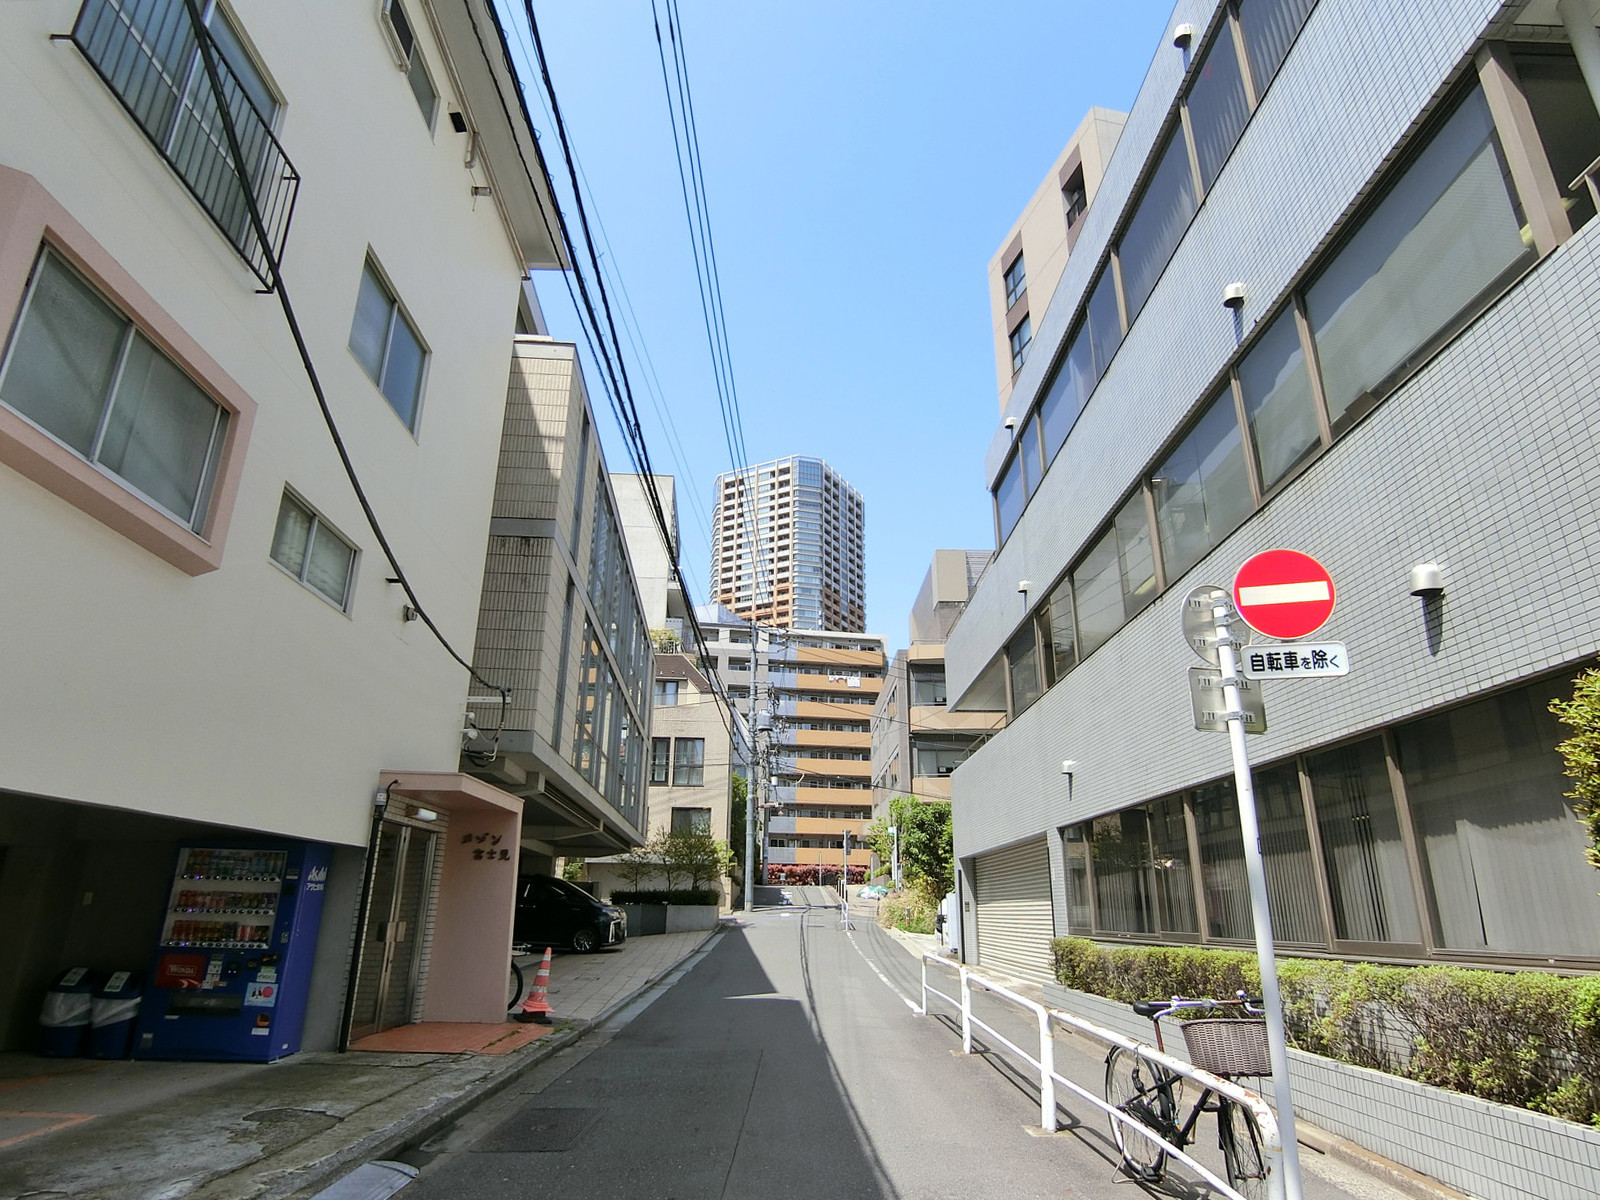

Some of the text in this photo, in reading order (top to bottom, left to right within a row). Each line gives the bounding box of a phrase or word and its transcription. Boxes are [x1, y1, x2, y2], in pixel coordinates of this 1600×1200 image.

[1250, 649, 1340, 672] 自転車を除く
